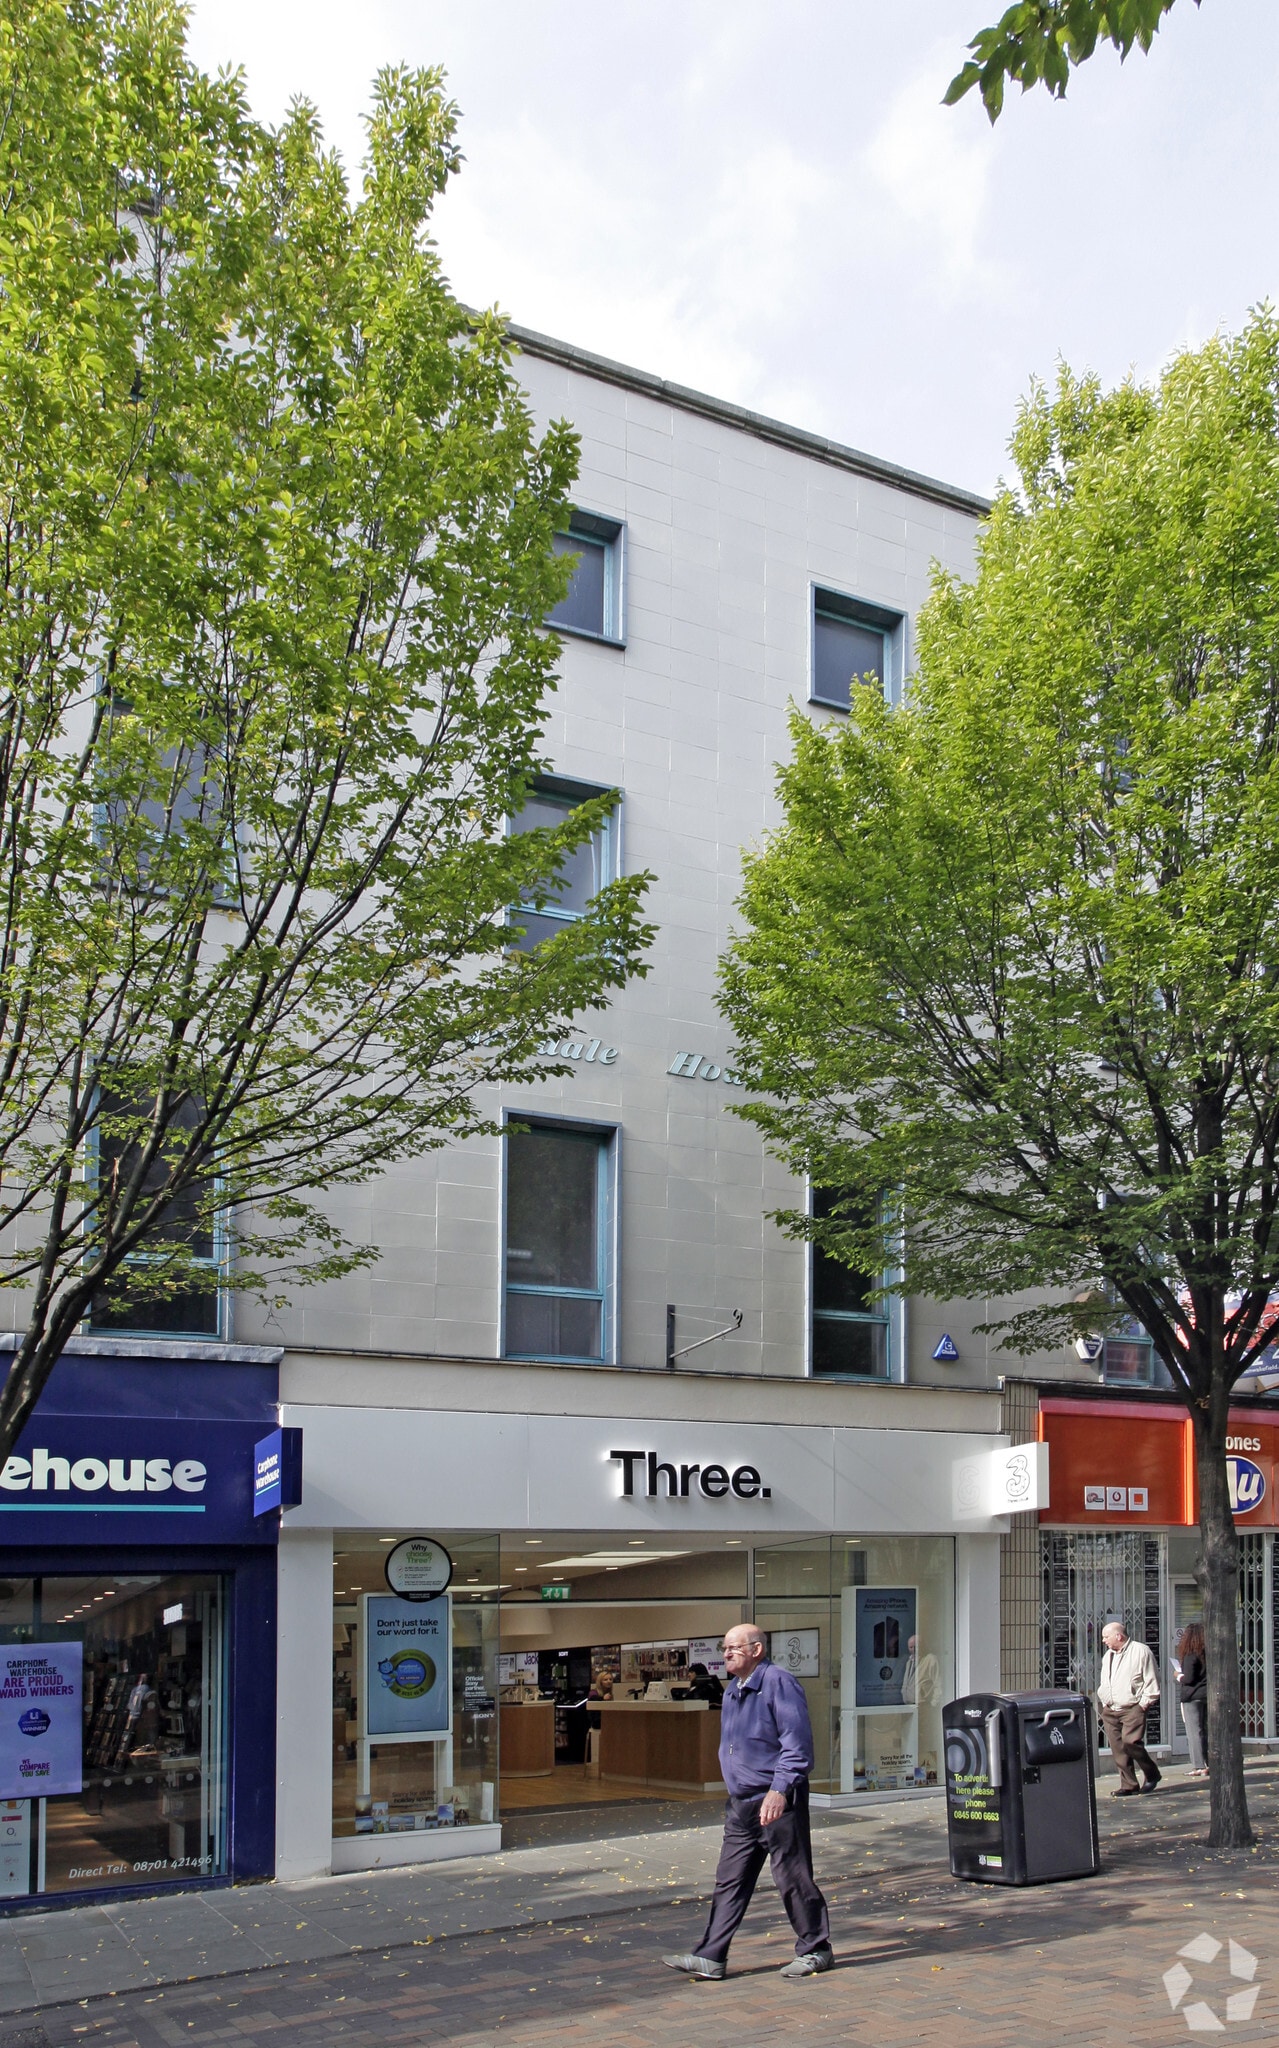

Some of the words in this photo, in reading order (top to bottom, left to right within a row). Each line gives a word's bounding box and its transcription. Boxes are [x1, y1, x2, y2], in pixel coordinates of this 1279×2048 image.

[666, 1050, 763, 1086] Hou
[1225, 1436, 1261, 1451] ones
[258, 1454, 278, 1474] Carphone
[0, 1448, 207, 1492] ehouse
[610, 1450, 771, 1498] Three.
[256, 1468, 280, 1489] Warehouse
[1006, 1455, 1030, 1497] 3
[411, 1544, 427, 1552] Why
[377, 1619, 400, 1627] Don't
[402, 1619, 418, 1628] just
[394, 1628, 416, 1636] word
[418, 1627, 430, 1635] for
[431, 1627, 439, 1635] it.
[6, 1659, 48, 1669] CARPHONE
[10, 1667, 57, 1677] WAREHOUSE
[4, 1677, 25, 1688] ARE
[28, 1675, 63, 1687] PROUD
[0, 1688, 27, 1699] WARD
[30, 1685, 74, 1697] WINNERS
[19, 1762, 51, 1772] COMPARE
[22, 1770, 34, 1778] YOU
[35, 1769, 51, 1777] SAVE
[953, 1773, 963, 1783] To
[955, 1786, 971, 1795] here
[972, 1787, 995, 1797] please
[965, 1799, 987, 1809] phone
[953, 1810, 970, 1820] 0845
[970, 1811, 983, 1820] 600
[68, 1867, 103, 1879] Direct
[106, 1864, 127, 1874] Tel:
[132, 1859, 168, 1873] 08701
[170, 1854, 213, 1870] 421496
